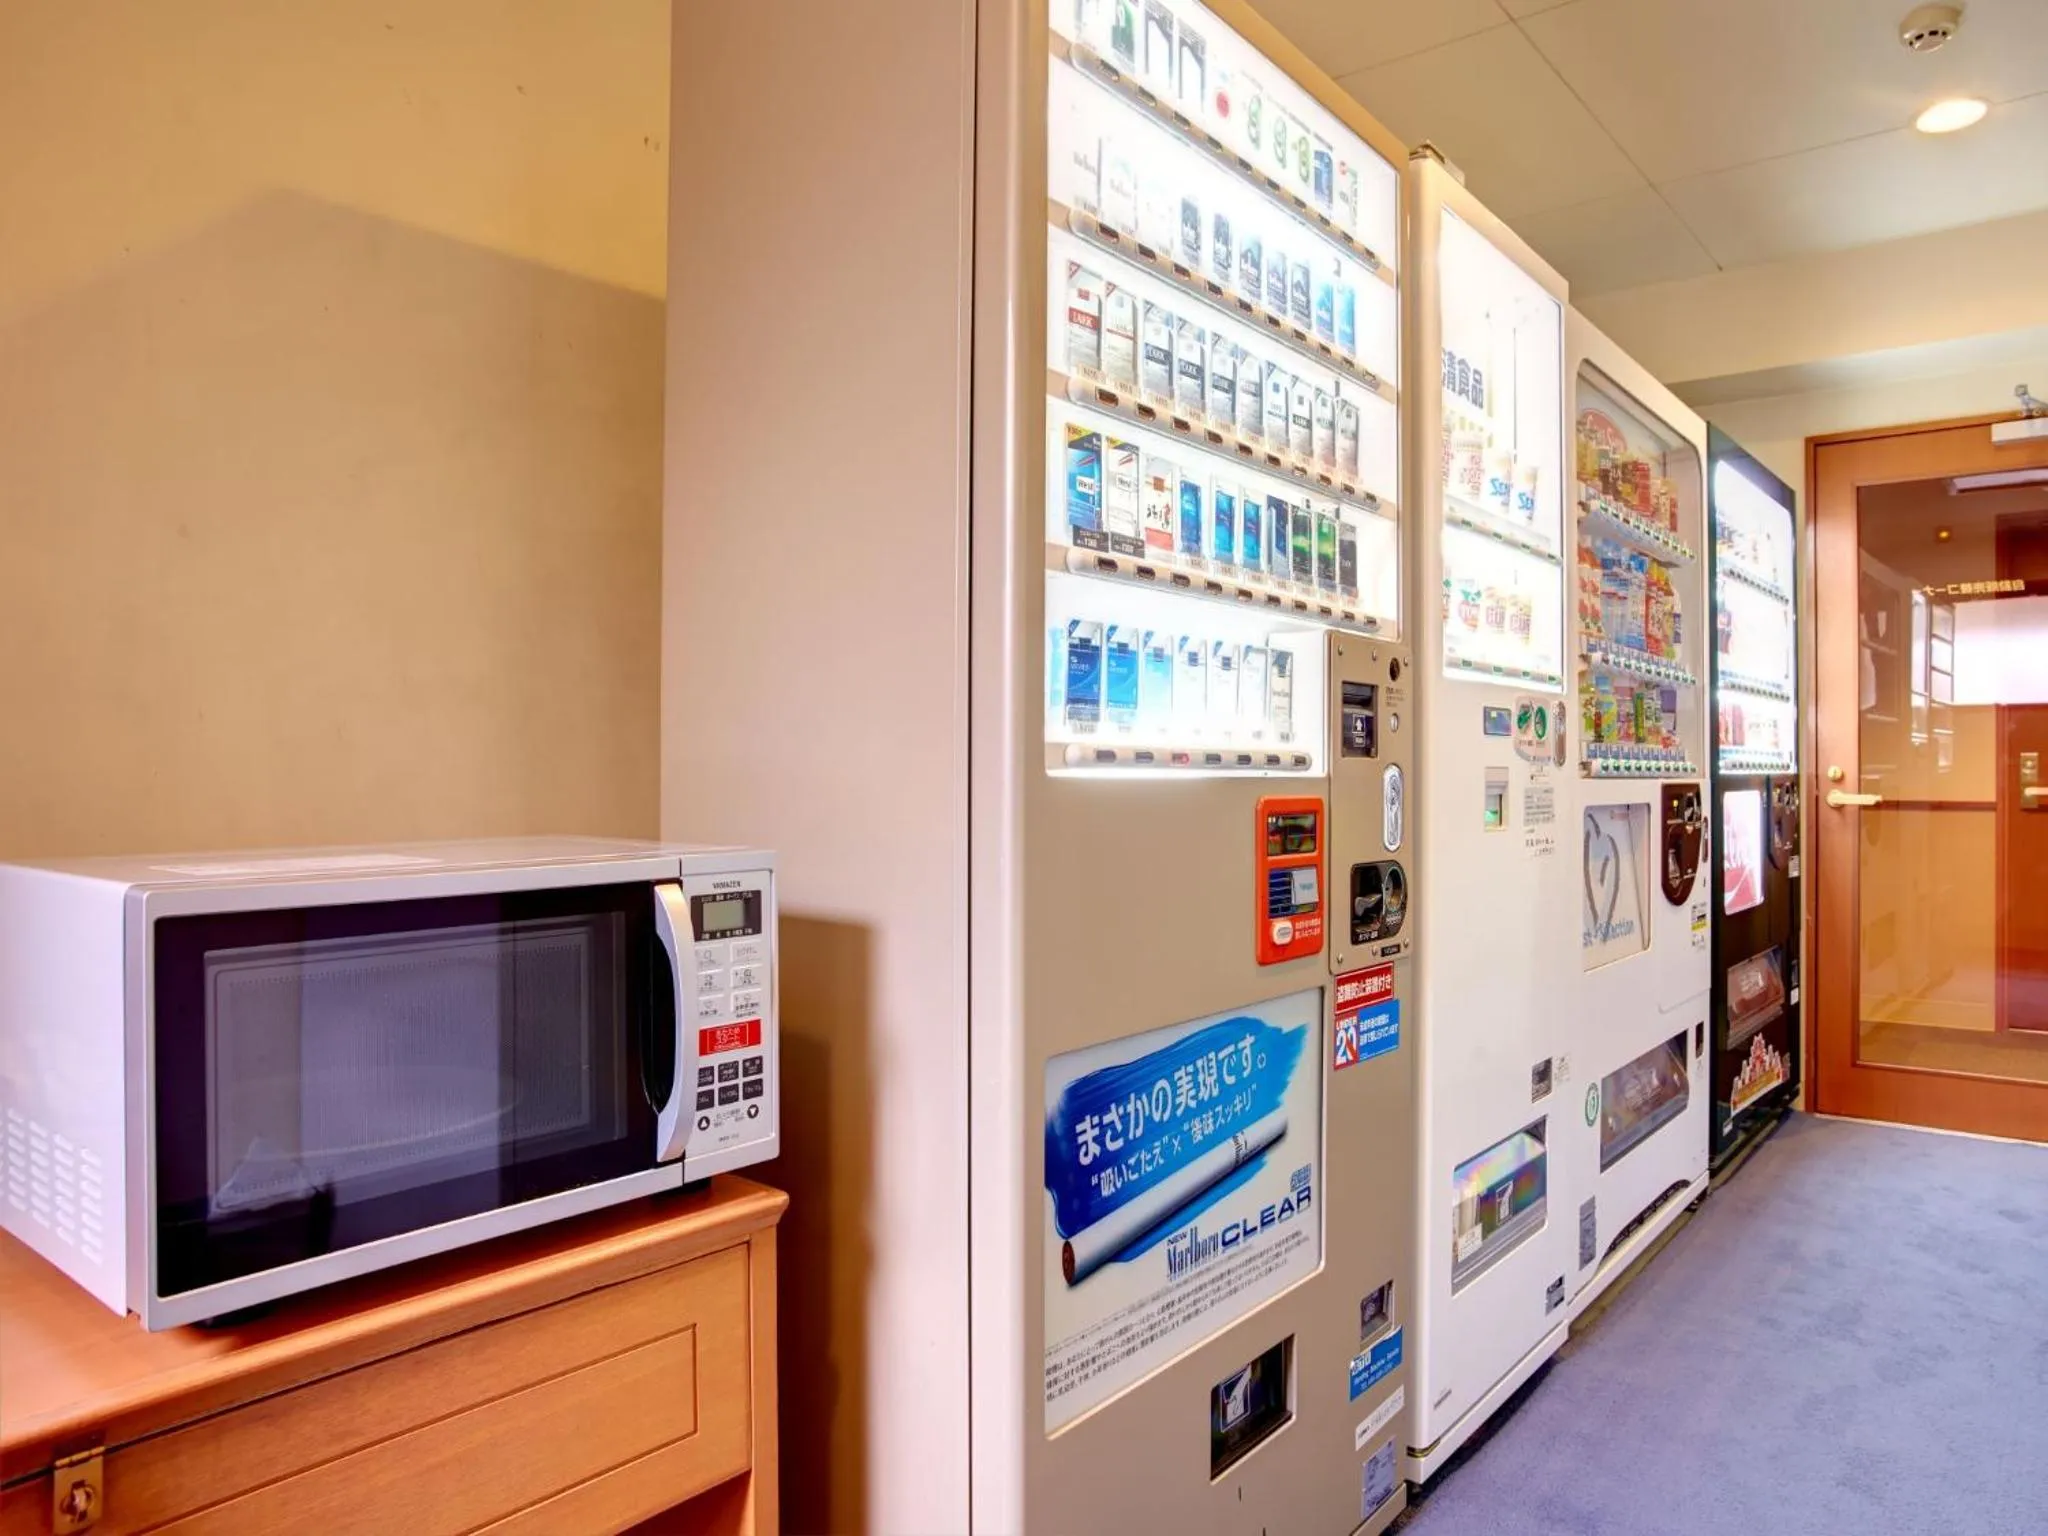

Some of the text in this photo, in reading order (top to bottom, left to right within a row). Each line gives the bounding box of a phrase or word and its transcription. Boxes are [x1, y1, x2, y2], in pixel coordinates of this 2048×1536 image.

[1075, 1033, 1267, 1166] まさかの実現です。
[1167, 1231, 1188, 1246] NEW
[1221, 1186, 1311, 1248] CLEAR
